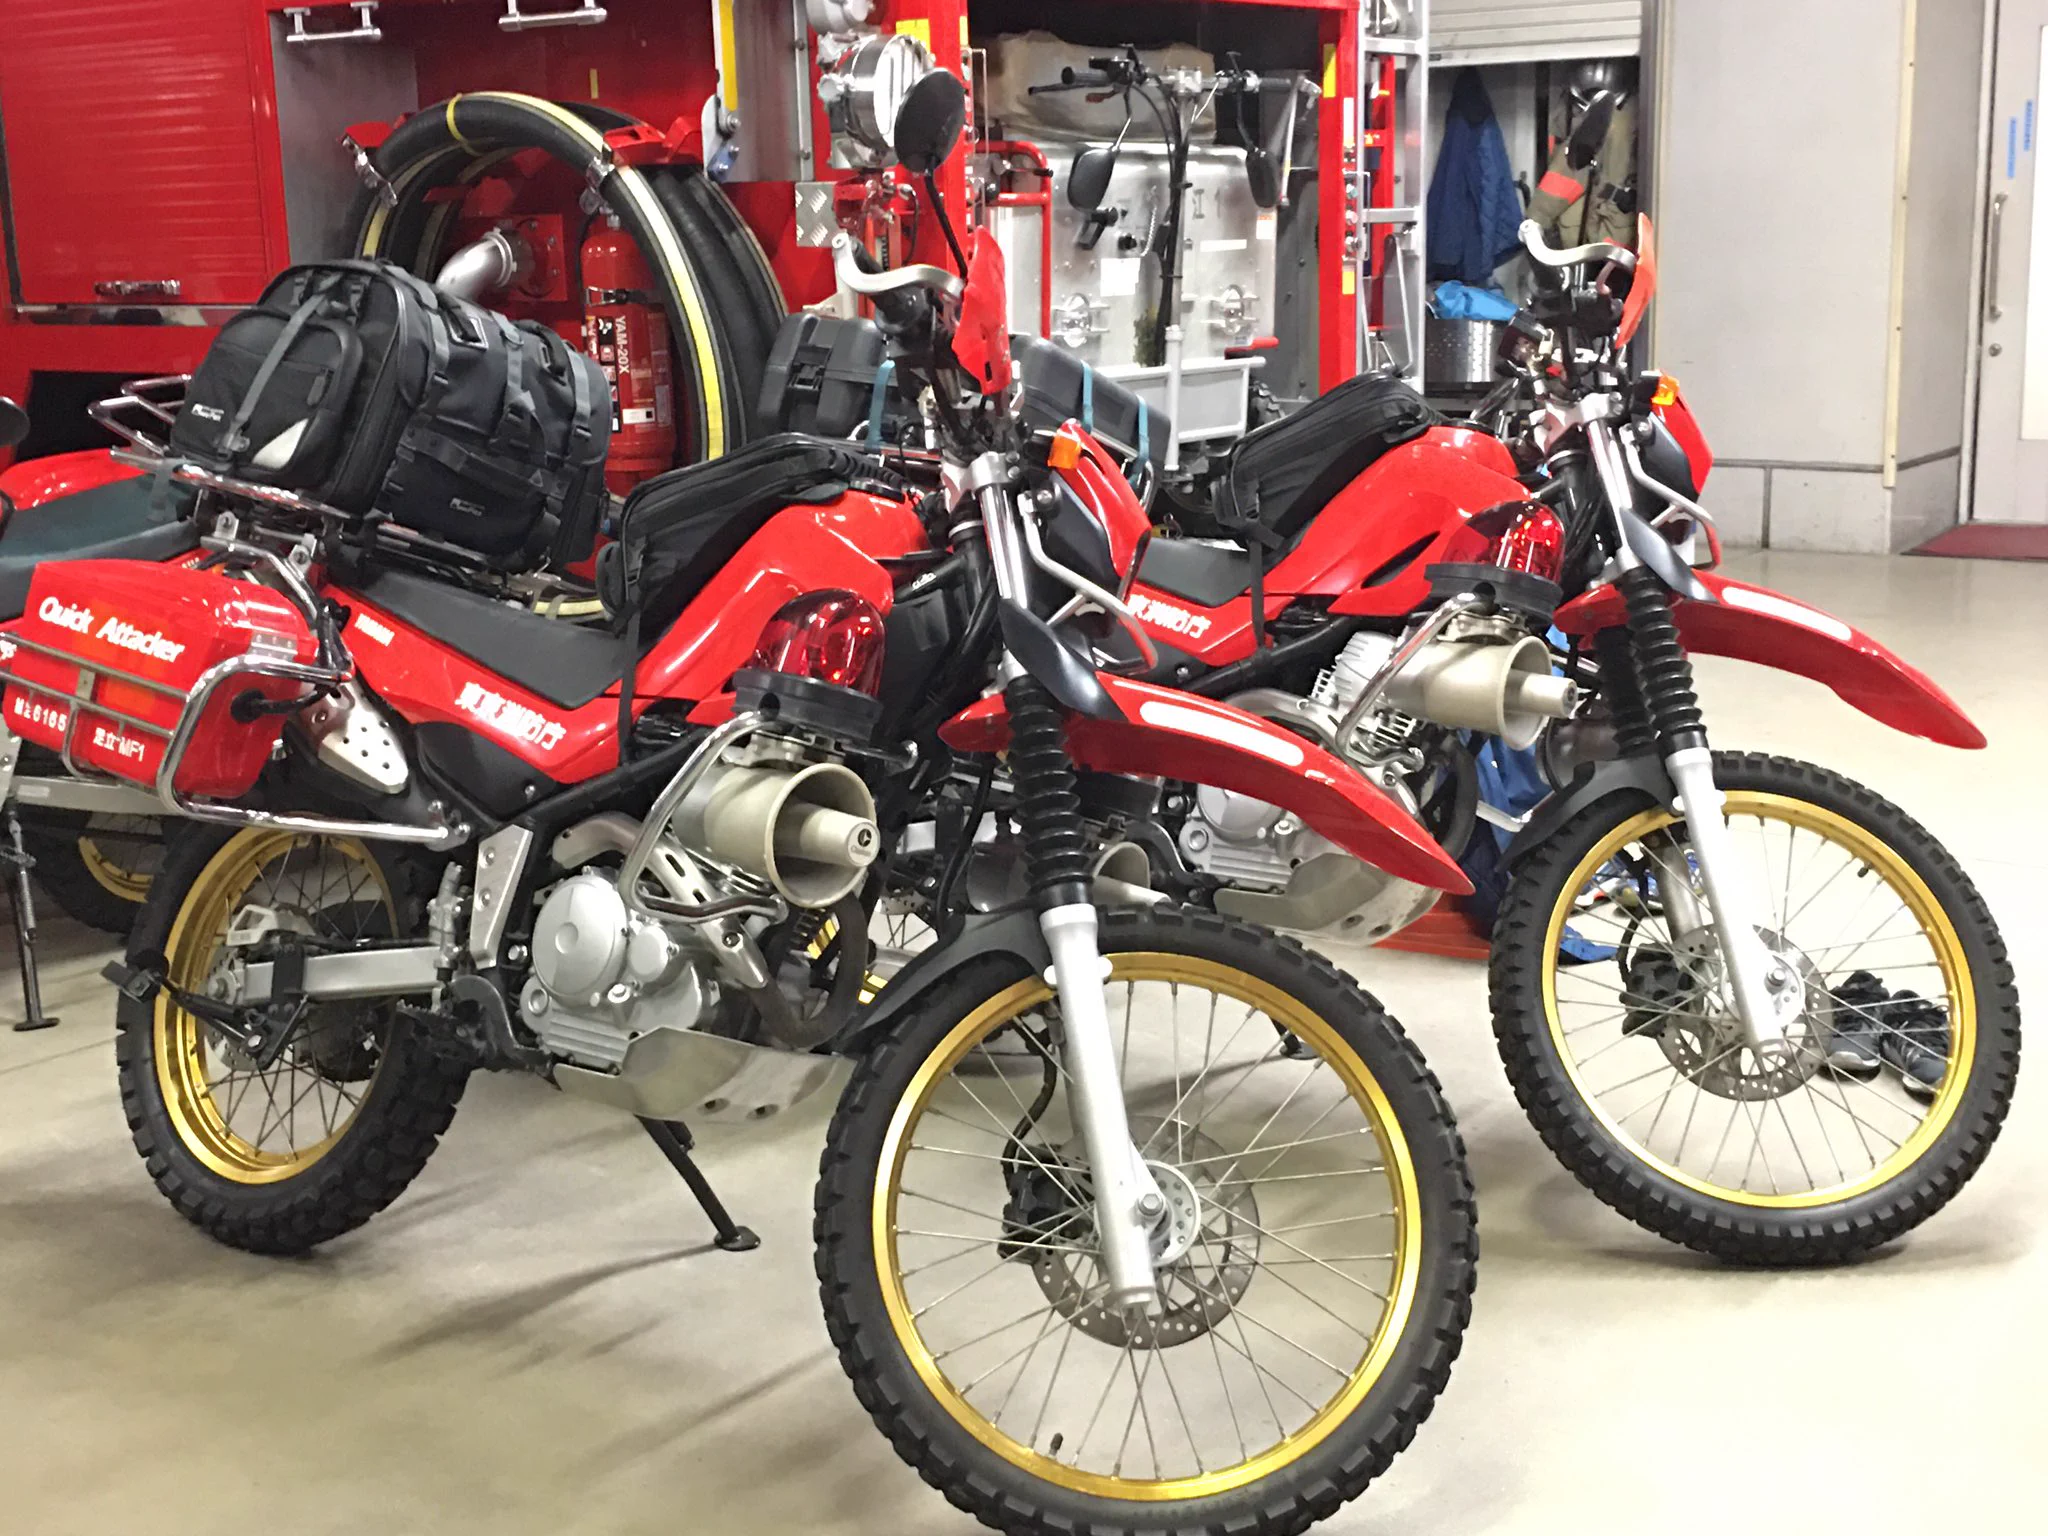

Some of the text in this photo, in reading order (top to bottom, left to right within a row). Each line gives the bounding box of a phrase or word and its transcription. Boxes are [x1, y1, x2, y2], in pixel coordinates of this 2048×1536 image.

[614, 315, 630, 373] YAM-20X
[39, 597, 186, 662] Quick Attacker
[455, 682, 567, 750] 東京消防庁
